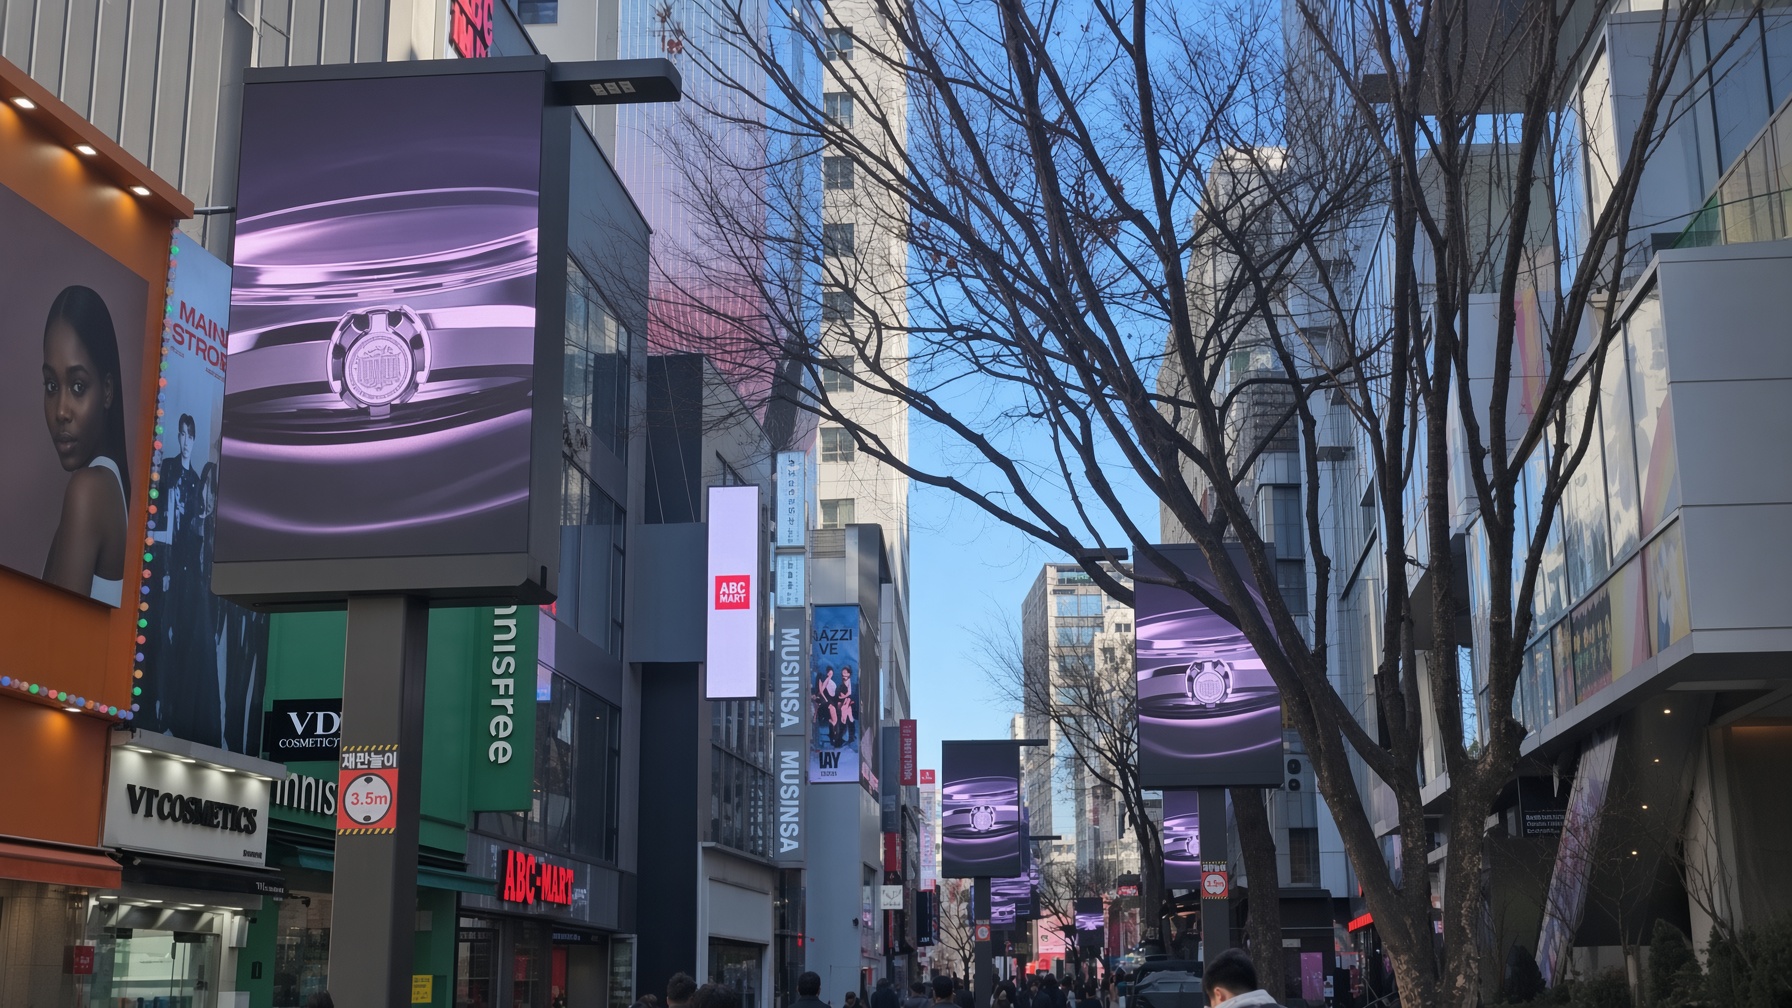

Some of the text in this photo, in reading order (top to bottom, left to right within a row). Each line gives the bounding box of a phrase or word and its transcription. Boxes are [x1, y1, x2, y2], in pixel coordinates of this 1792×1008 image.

[179, 300, 228, 349] MAIN
[719, 593, 747, 604] MART
[720, 582, 746, 594] ABC
[781, 628, 800, 729] MUSINSA
[287, 711, 343, 735] VD
[350, 792, 388, 806] 3.5m
[780, 750, 799, 853] MUSINSA
